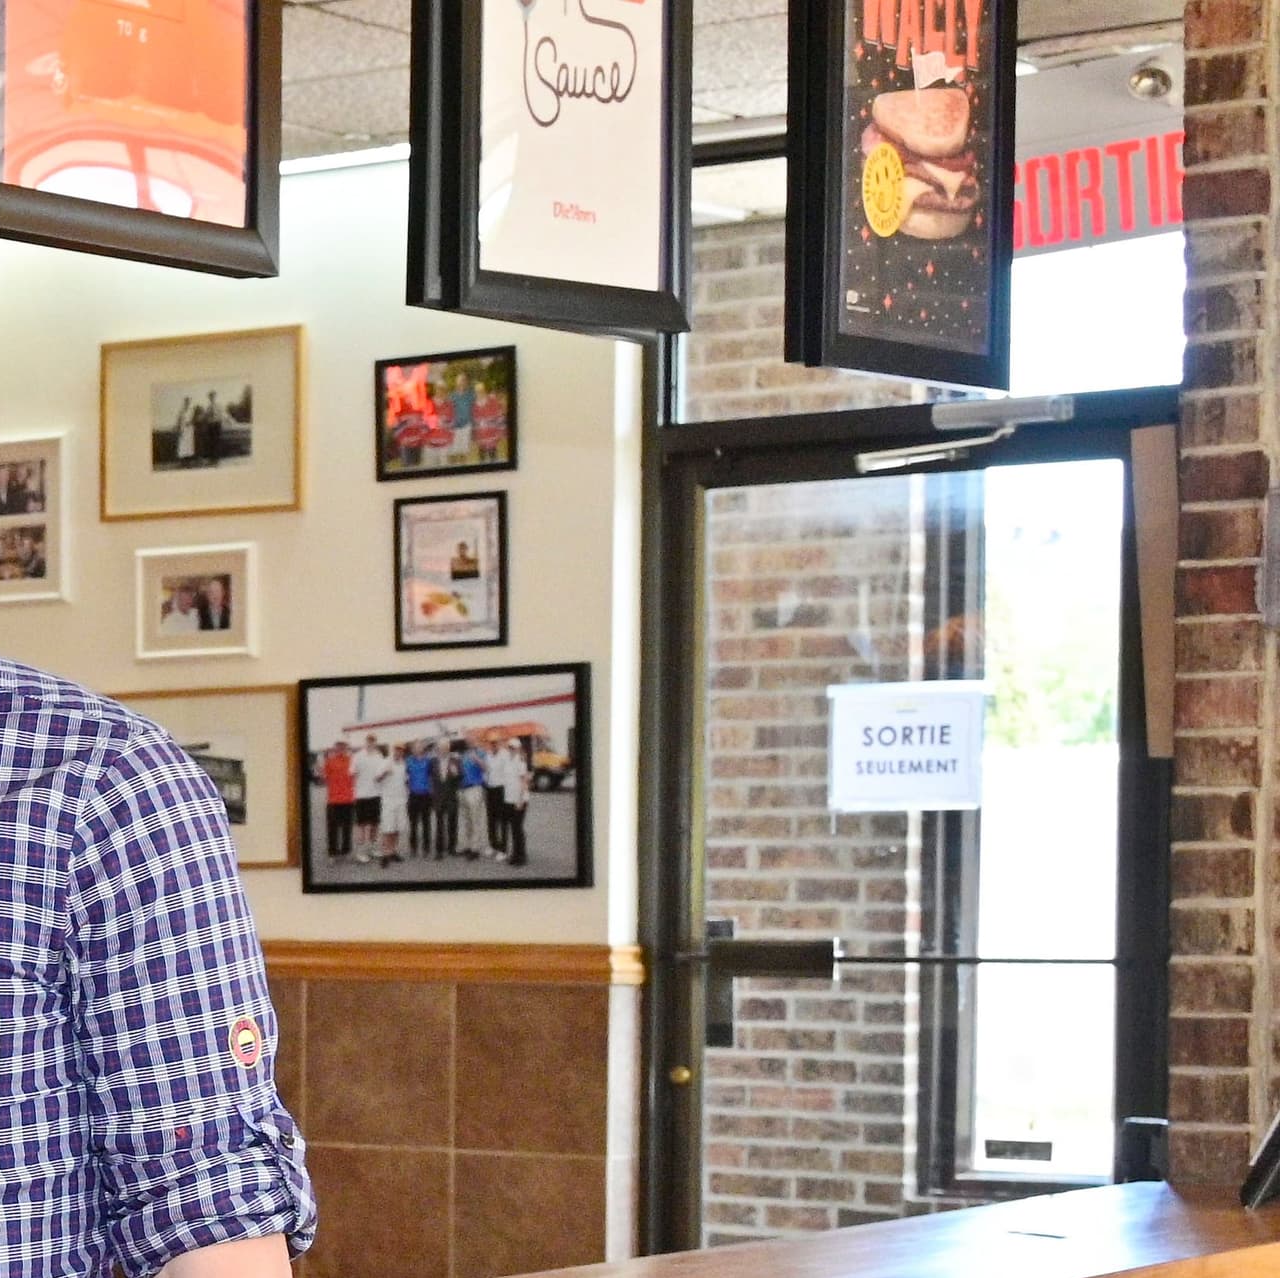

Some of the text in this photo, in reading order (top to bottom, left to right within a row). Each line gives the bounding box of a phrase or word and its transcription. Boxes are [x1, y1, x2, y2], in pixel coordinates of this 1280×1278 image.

[525, 36, 627, 128] Sauce
[862, 725, 952, 746] SORTIE
[855, 758, 960, 776] SEULEMENT
